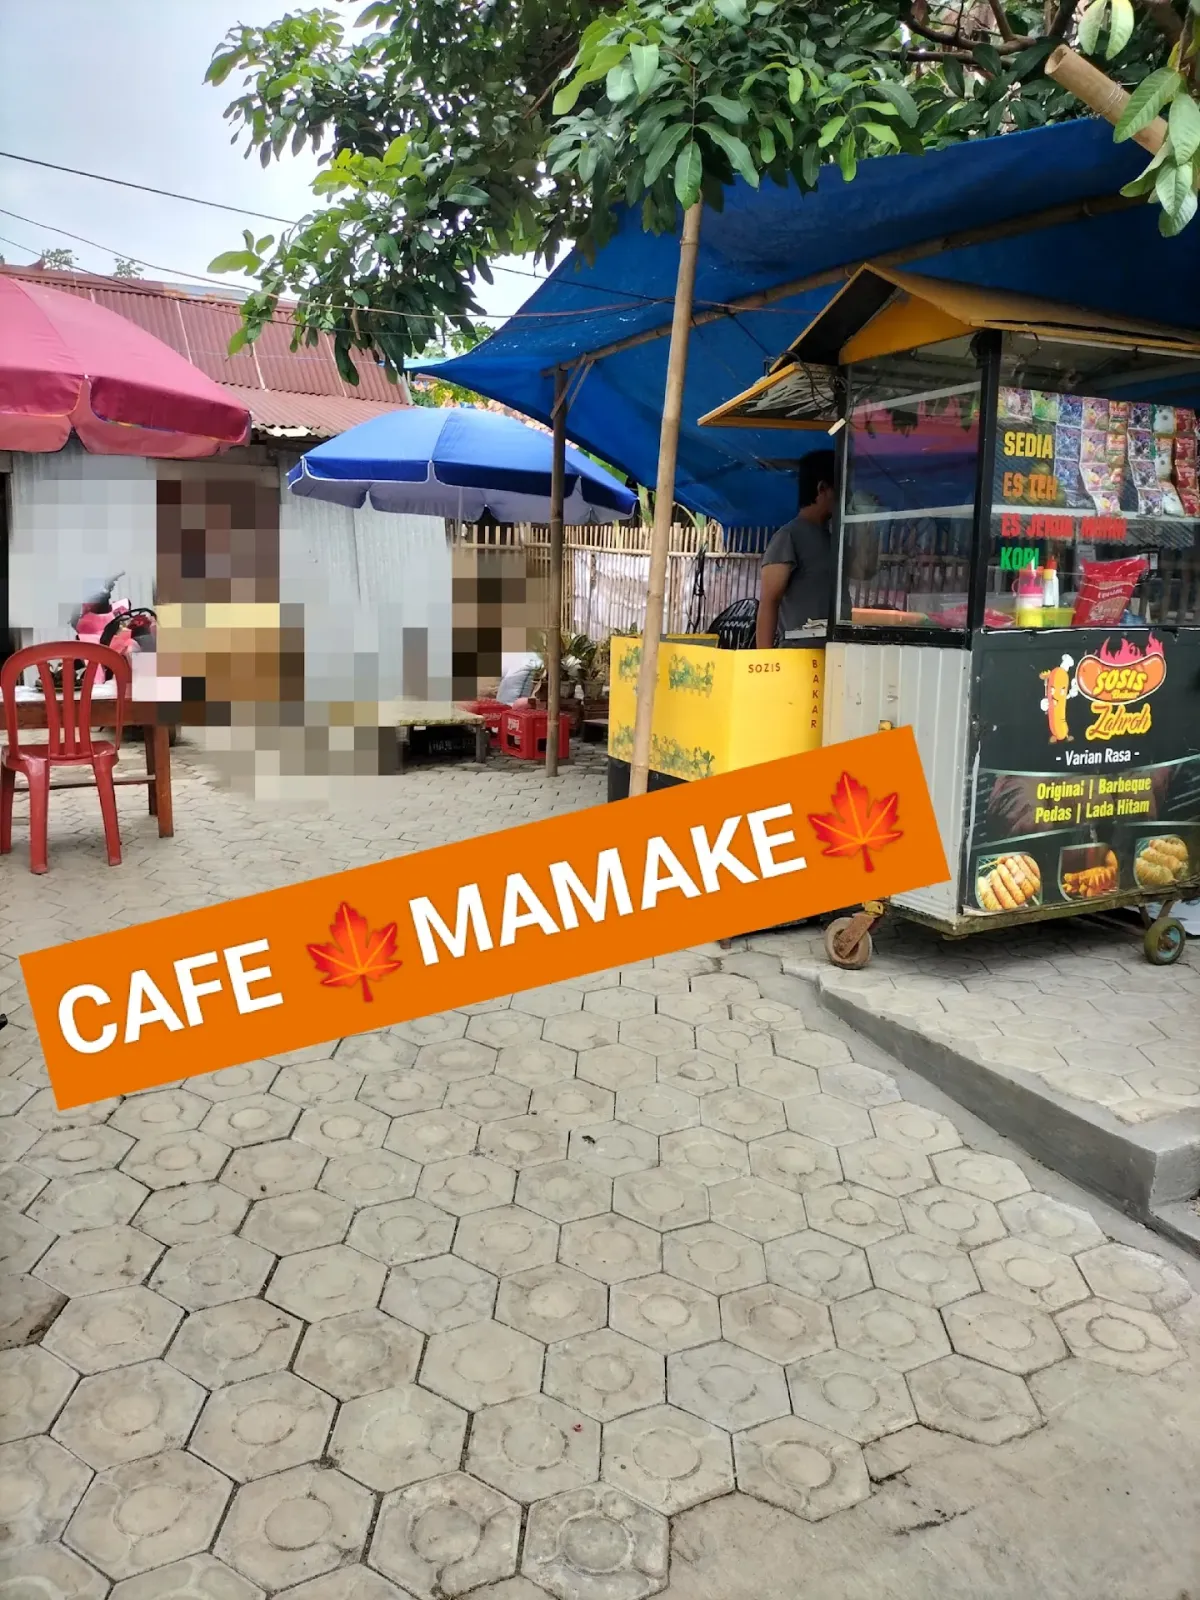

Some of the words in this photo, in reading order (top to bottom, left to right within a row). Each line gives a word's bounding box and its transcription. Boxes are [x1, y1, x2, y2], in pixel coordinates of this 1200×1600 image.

[1003, 431, 1054, 459] SEDIA
[1003, 471, 1023, 497] ES
[1029, 474, 1058, 501] TEH
[1001, 513, 1021, 537] ES
[1000, 547, 1040, 571] KOPI
[748, 662, 781, 674] SOZIS
[1093, 668, 1147, 695] SOSIS
[1085, 701, 1152, 741] Zahroh
[1065, 749, 1102, 766] Varian
[1104, 747, 1132, 763] Rasa
[1098, 776, 1152, 795] Barbeque
[1035, 805, 1072, 824] Pedas
[1085, 801, 1114, 818] Lada
[1116, 798, 1150, 815] Hitam
